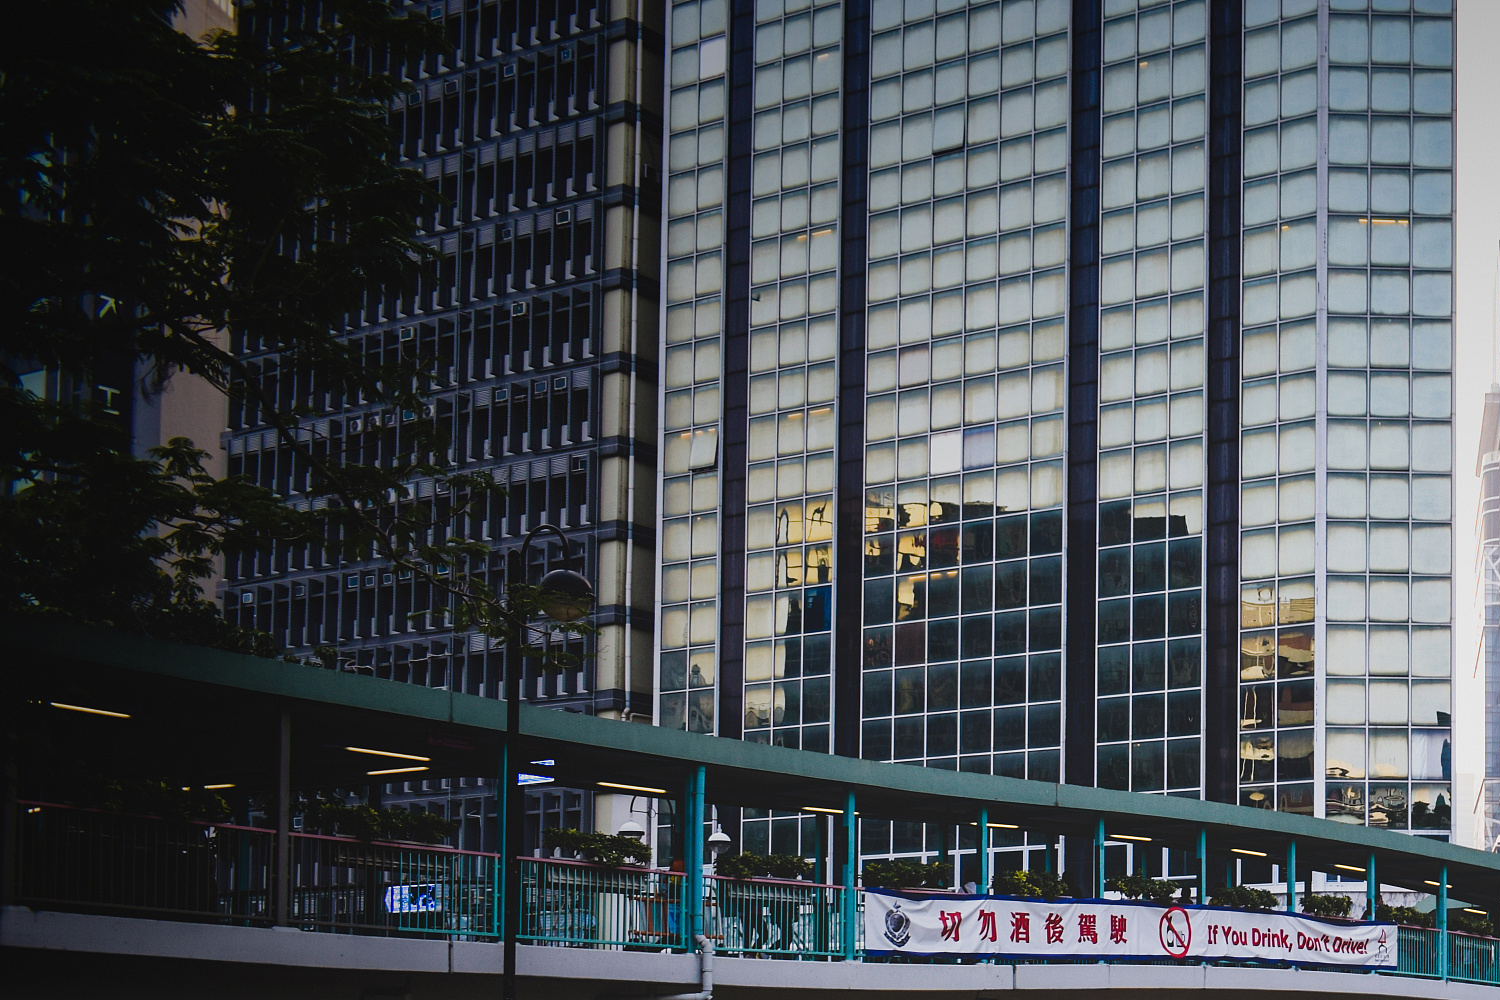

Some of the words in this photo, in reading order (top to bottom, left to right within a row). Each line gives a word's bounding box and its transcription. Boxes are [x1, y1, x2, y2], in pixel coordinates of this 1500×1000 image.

[938, 909, 1128, 944] 切勿酒後駕駛
[1207, 924, 1218, 945] If
[1221, 925, 1248, 946] You
[1251, 928, 1293, 953] Drink,
[1297, 931, 1330, 953] Don't
[1332, 936, 1369, 955] Drive!
